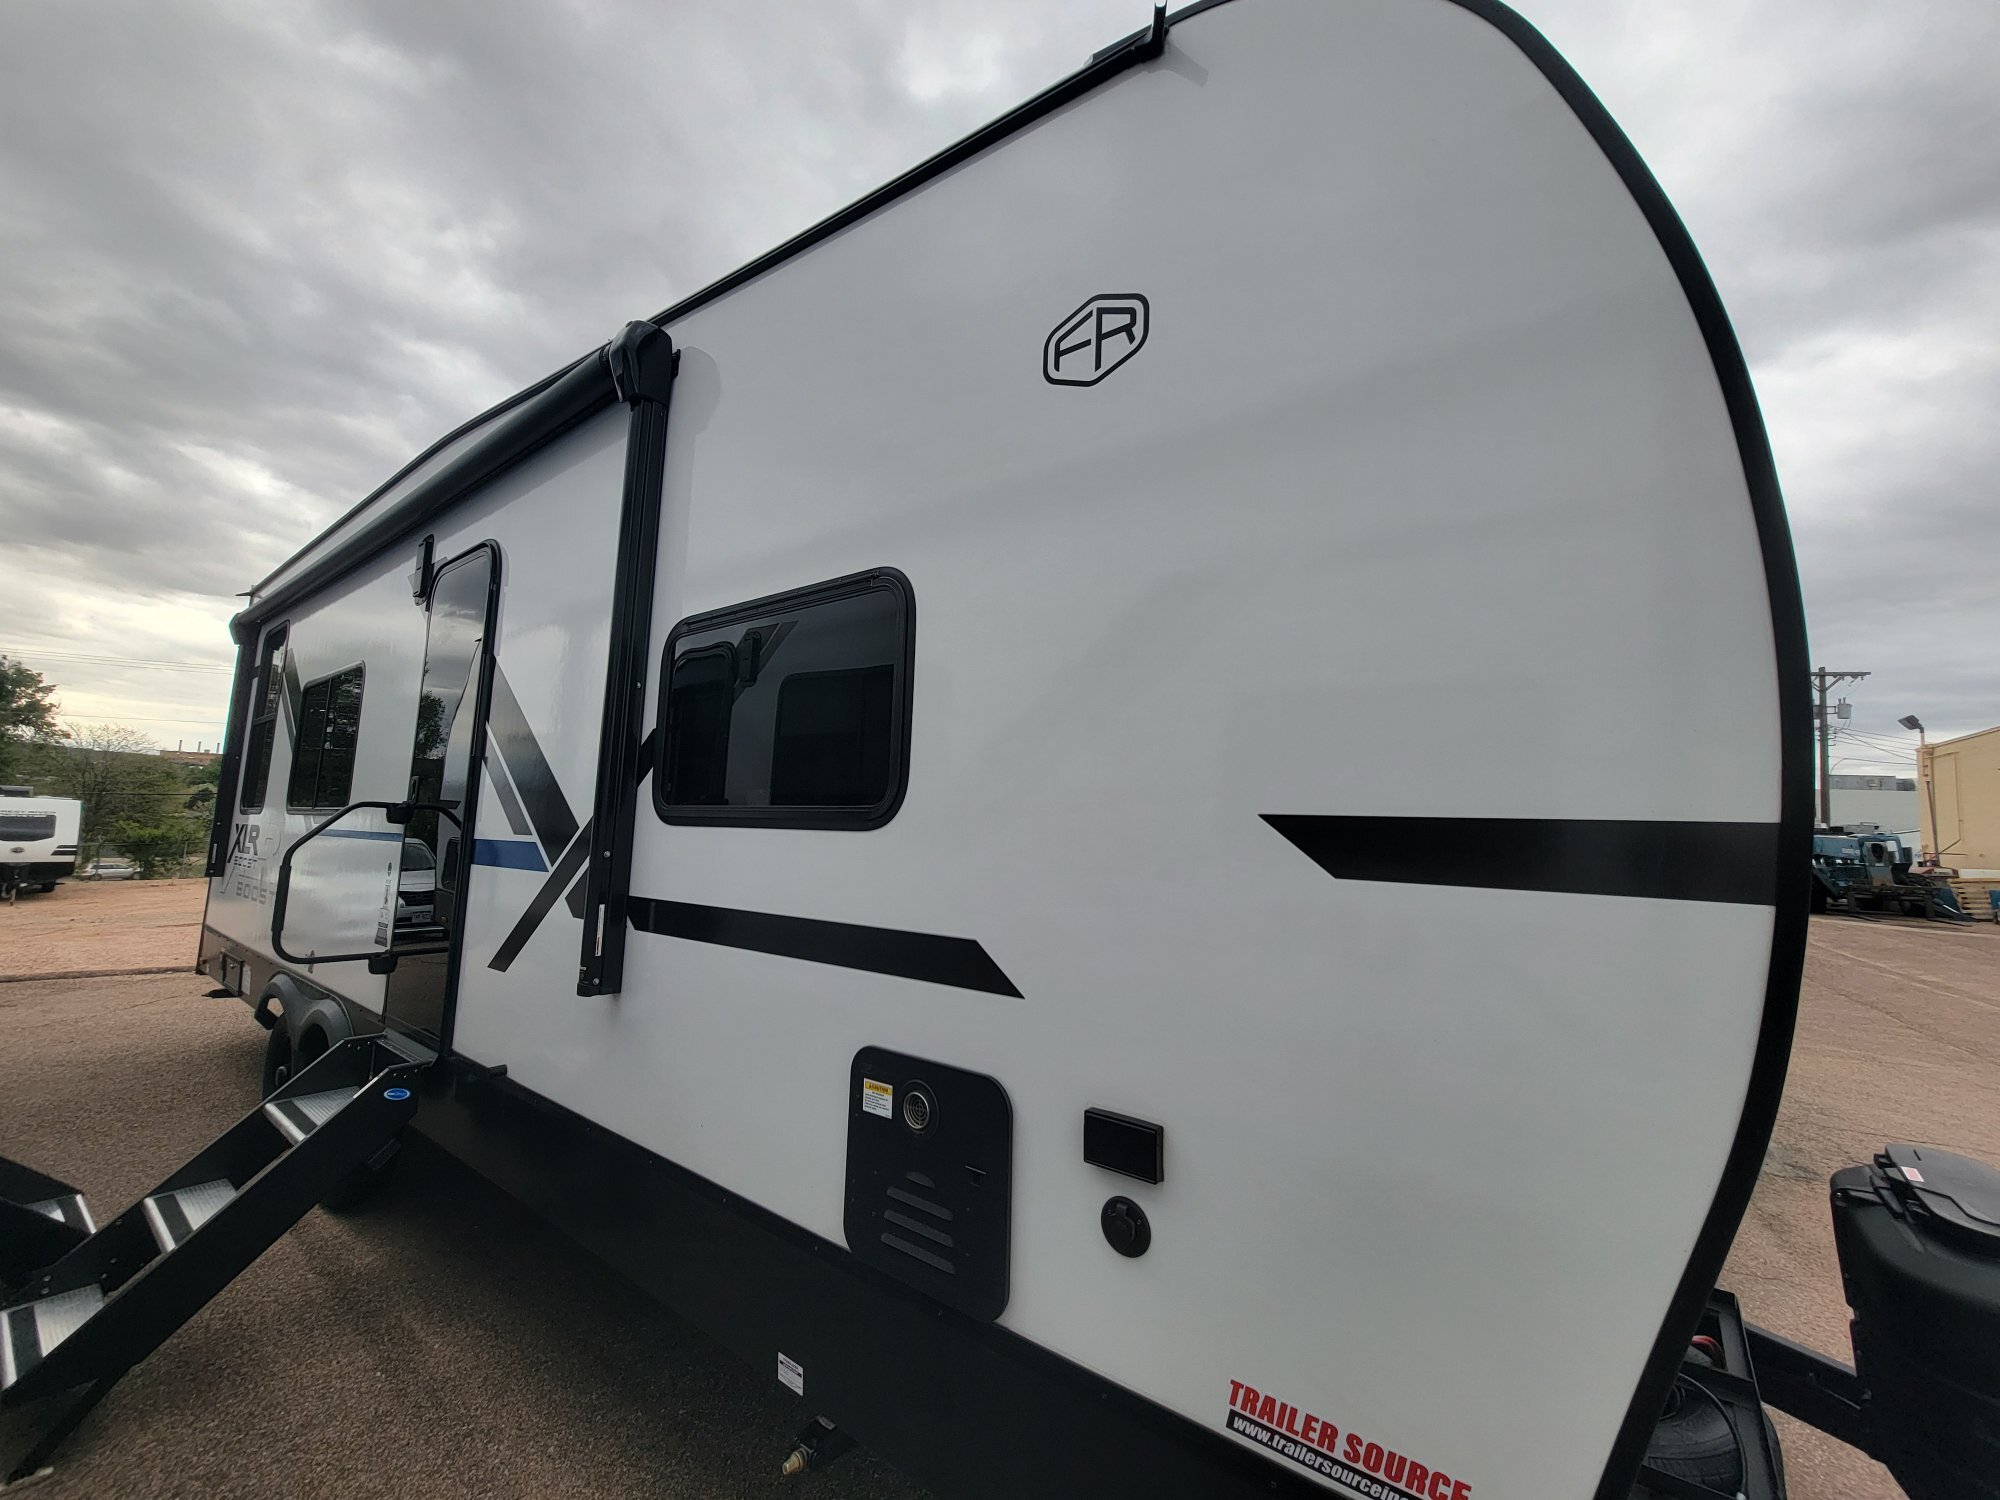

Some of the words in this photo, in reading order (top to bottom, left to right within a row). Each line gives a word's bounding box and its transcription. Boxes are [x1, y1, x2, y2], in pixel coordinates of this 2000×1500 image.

[1053, 306, 1137, 373] FR
[227, 823, 260, 863] XLR
[1229, 1379, 1339, 1453] TRAILER
[1343, 1433, 1472, 1500] SOURCE
[1233, 1416, 1408, 1500] www.trailersourcein
